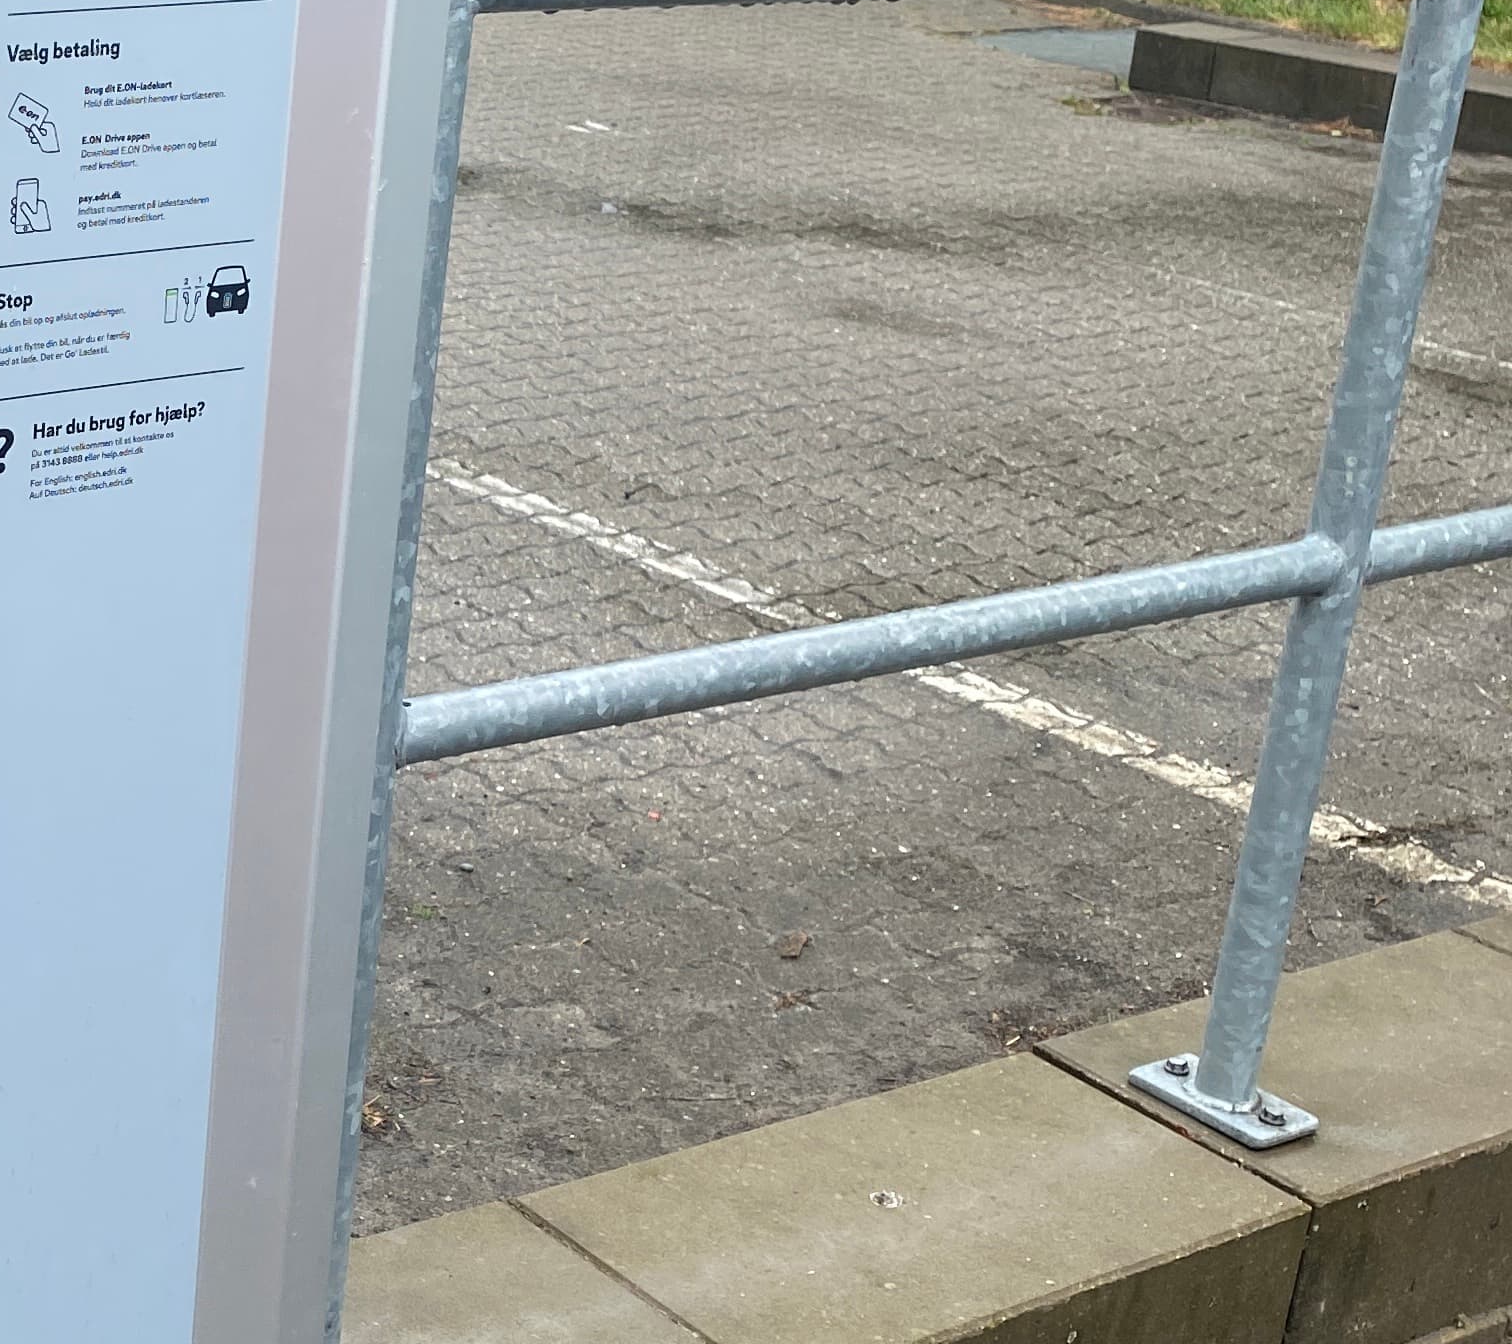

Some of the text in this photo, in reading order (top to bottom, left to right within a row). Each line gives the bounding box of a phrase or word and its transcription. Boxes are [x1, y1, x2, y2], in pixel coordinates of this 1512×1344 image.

[7, 39, 120, 64] Vælg betaling
[85, 81, 172, 95] Brug dit E.ON-ladekort
[104, 96, 113, 106] dit
[116, 94, 146, 105] ladekort
[149, 93, 177, 103] henover
[82, 134, 150, 144] E.ON Drive appen
[81, 148, 119, 158] Download
[121, 146, 140, 154] E.ON
[142, 144, 161, 153] Drive
[163, 143, 186, 152] appen
[188, 142, 196, 150] og
[80, 163, 97, 171] med
[79, 191, 121, 204] pay.edri.dk
[147, 200, 156, 210] på
[77, 221, 87, 230] og
[89, 218, 107, 227] betal
[109, 216, 125, 225] med
[9, 318, 21, 327] din
[24, 341, 44, 352] flytte
[46, 339, 57, 348] din
[72, 335, 84, 345] når
[86, 334, 95, 343] du
[41, 352, 53, 362] Det
[56, 352, 63, 360] er
[33, 401, 205, 439] Har du brug for hjælp?
[71, 440, 113, 452] velkommen
[31, 460, 40, 471] på
[42, 458, 60, 468] 3143
[85, 452, 100, 462] eller
[29, 492, 43, 500] Auf
